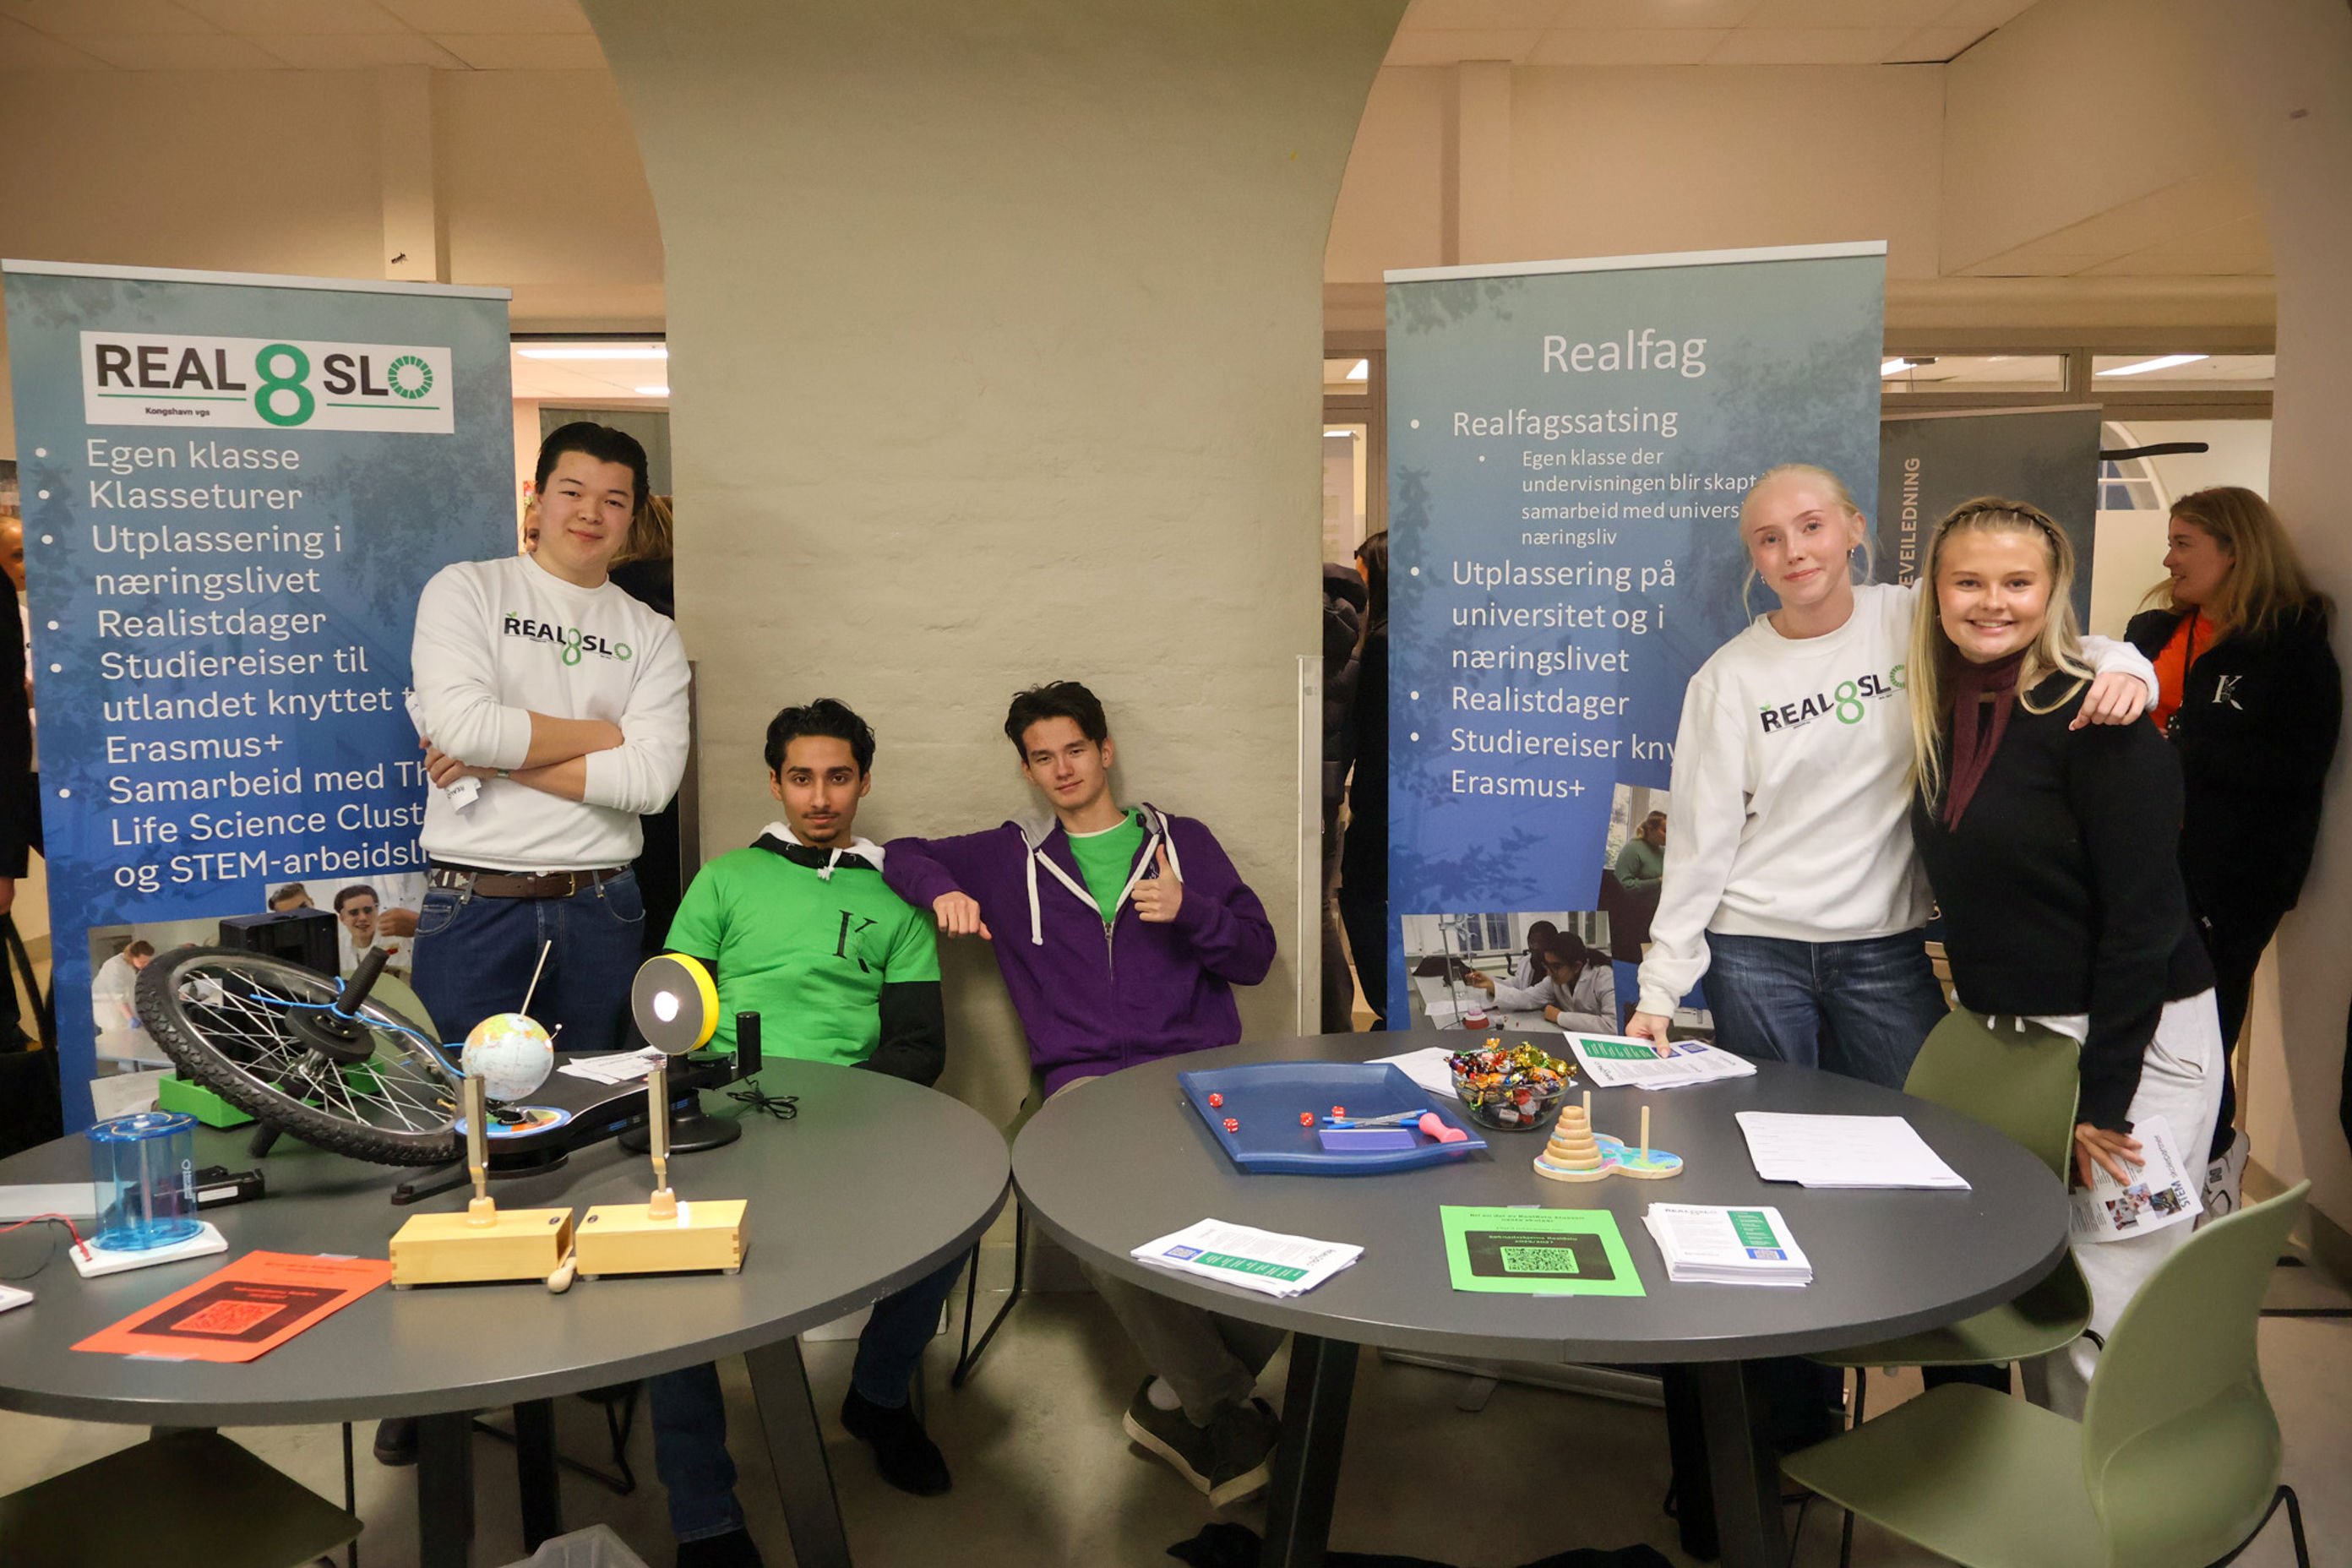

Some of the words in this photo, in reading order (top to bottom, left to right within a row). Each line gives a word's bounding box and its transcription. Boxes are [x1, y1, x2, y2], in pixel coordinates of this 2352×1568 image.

[1544, 329, 1707, 378] Realfag
[145, 407, 193, 416] Kongshavn
[195, 409, 210, 417] vgs
[1453, 406, 1678, 440] Realfagssatsing
[87, 438, 176, 475] Egen
[189, 441, 300, 471] klasse
[1522, 450, 1566, 470] Egen
[1571, 448, 1627, 466] klasse
[1631, 448, 1664, 466] der
[89, 480, 303, 510] Klasseturer
[1522, 474, 1666, 494] undervisningen
[1669, 473, 1701, 492] blir
[1704, 473, 1756, 494] skapt
[1522, 502, 1619, 520] samarbeid
[1623, 501, 1665, 519] med
[1669, 501, 1745, 519] univers
[1898, 457, 1920, 585] EVEILEDNING
[92, 525, 324, 560] Utplassering
[335, 525, 342, 553] i
[1522, 527, 1617, 548] næringsliv
[95, 567, 320, 601] næringslivet
[1452, 560, 1631, 591] Utplassering
[1641, 559, 1676, 591] på
[98, 607, 327, 642] Realistdager
[1452, 603, 1606, 629] universitet
[1612, 609, 1648, 634] og
[1657, 604, 1664, 629] i
[101, 647, 324, 680] Studiereiser
[333, 646, 368, 673] til
[1451, 645, 1630, 676] næringslivet
[103, 689, 257, 722] utlandet
[268, 687, 393, 721] knyttet
[1451, 686, 1630, 721] Realistdager
[106, 732, 284, 764] Erasmus+
[1451, 727, 1623, 759] Studiereiser
[109, 766, 302, 804] Samarbeid
[313, 763, 385, 792] med
[1451, 770, 1587, 798] Erasmus+
[112, 812, 178, 847] Life
[189, 807, 326, 841] Science
[337, 802, 423, 831] Clust
[115, 865, 161, 893] og
[2170, 1180, 2191, 1208] STEM
